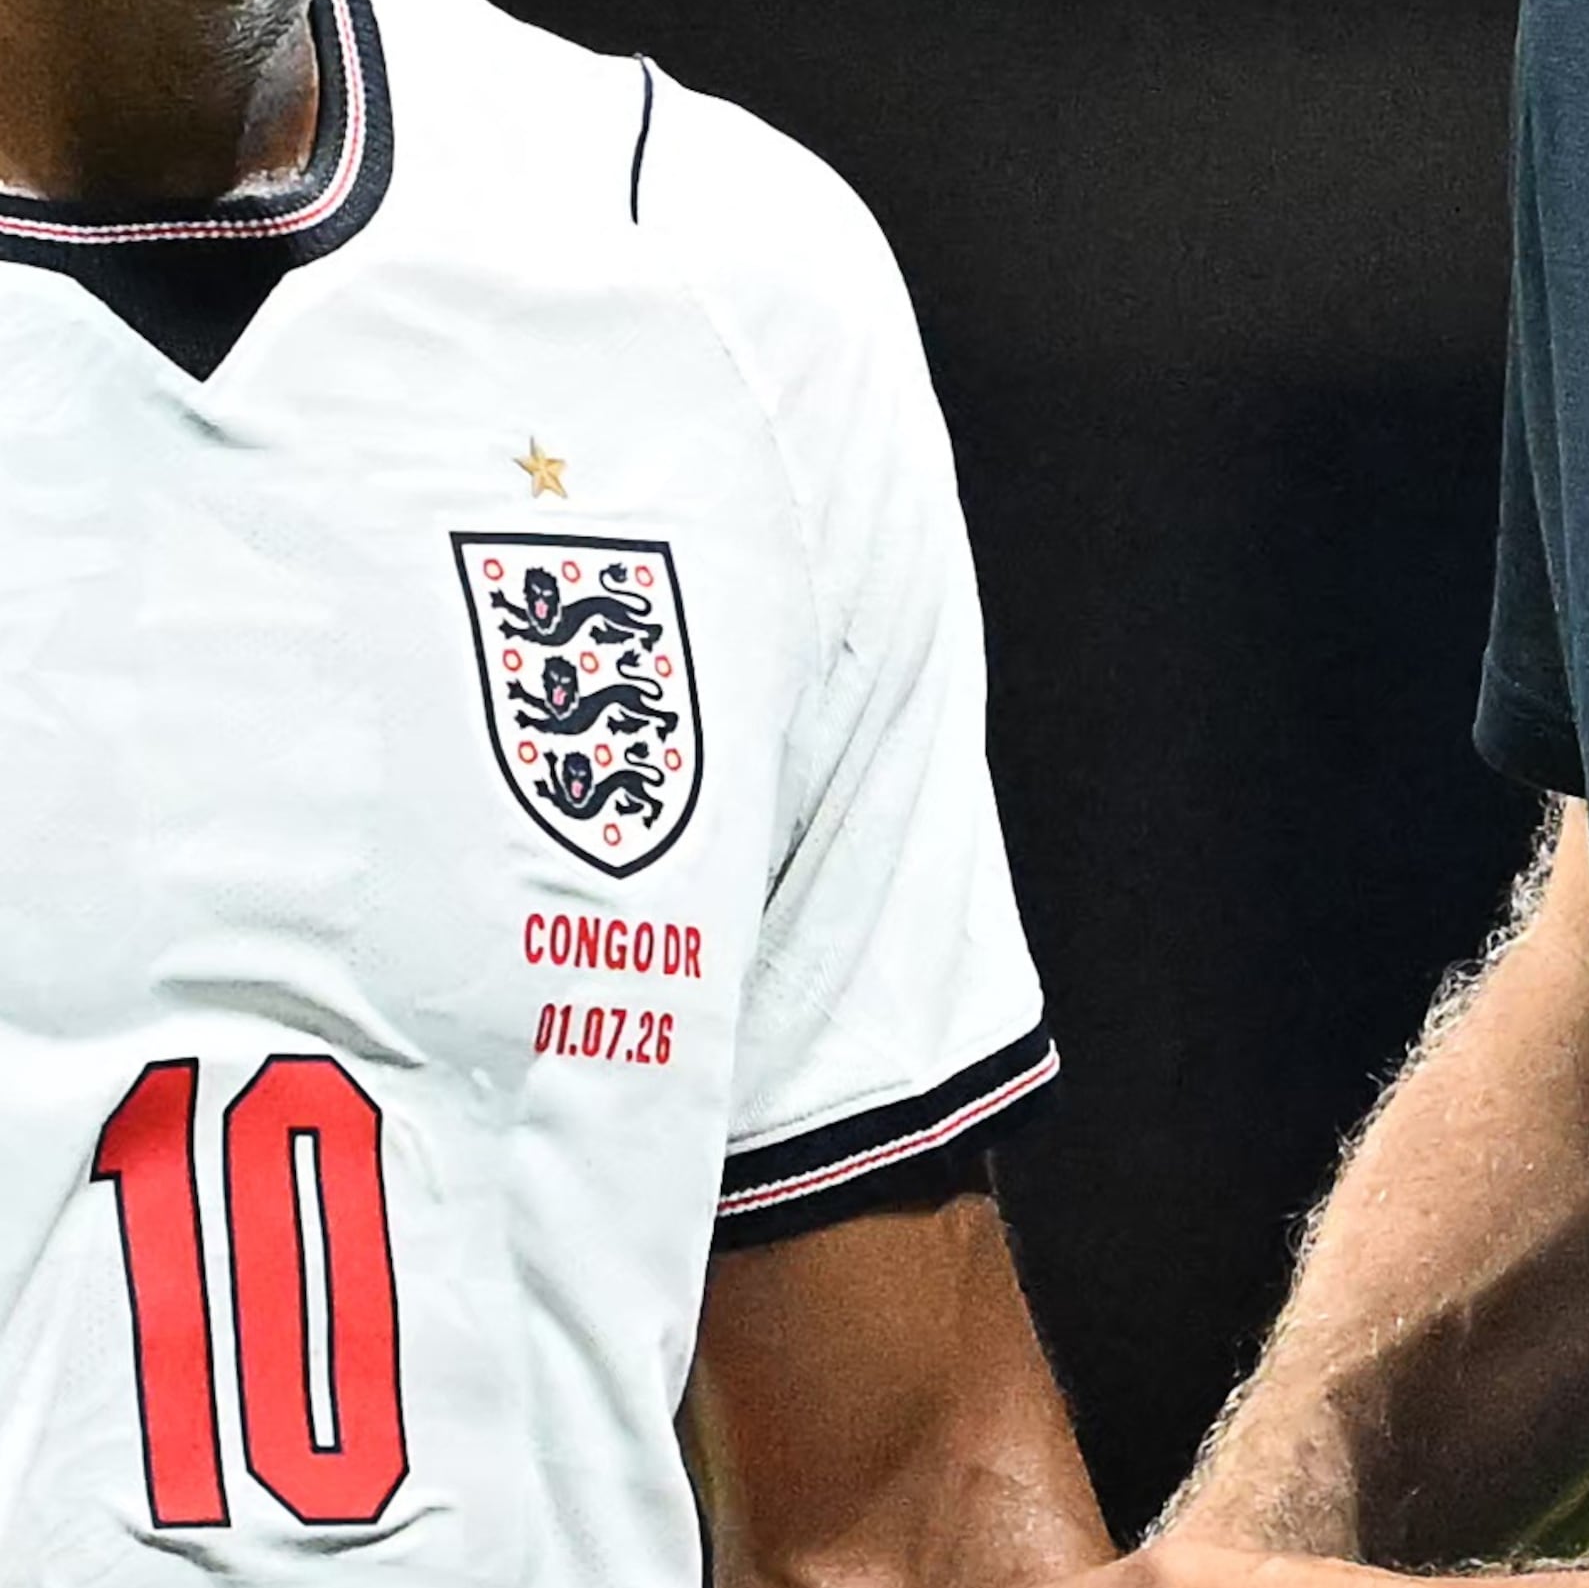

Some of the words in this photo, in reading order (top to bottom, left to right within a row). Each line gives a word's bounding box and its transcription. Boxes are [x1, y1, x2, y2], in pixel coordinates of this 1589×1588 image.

[524, 913, 655, 973] CONGO
[663, 923, 702, 979] DR
[533, 1003, 674, 1065] 01.07.26
[90, 1055, 409, 1527] 10
